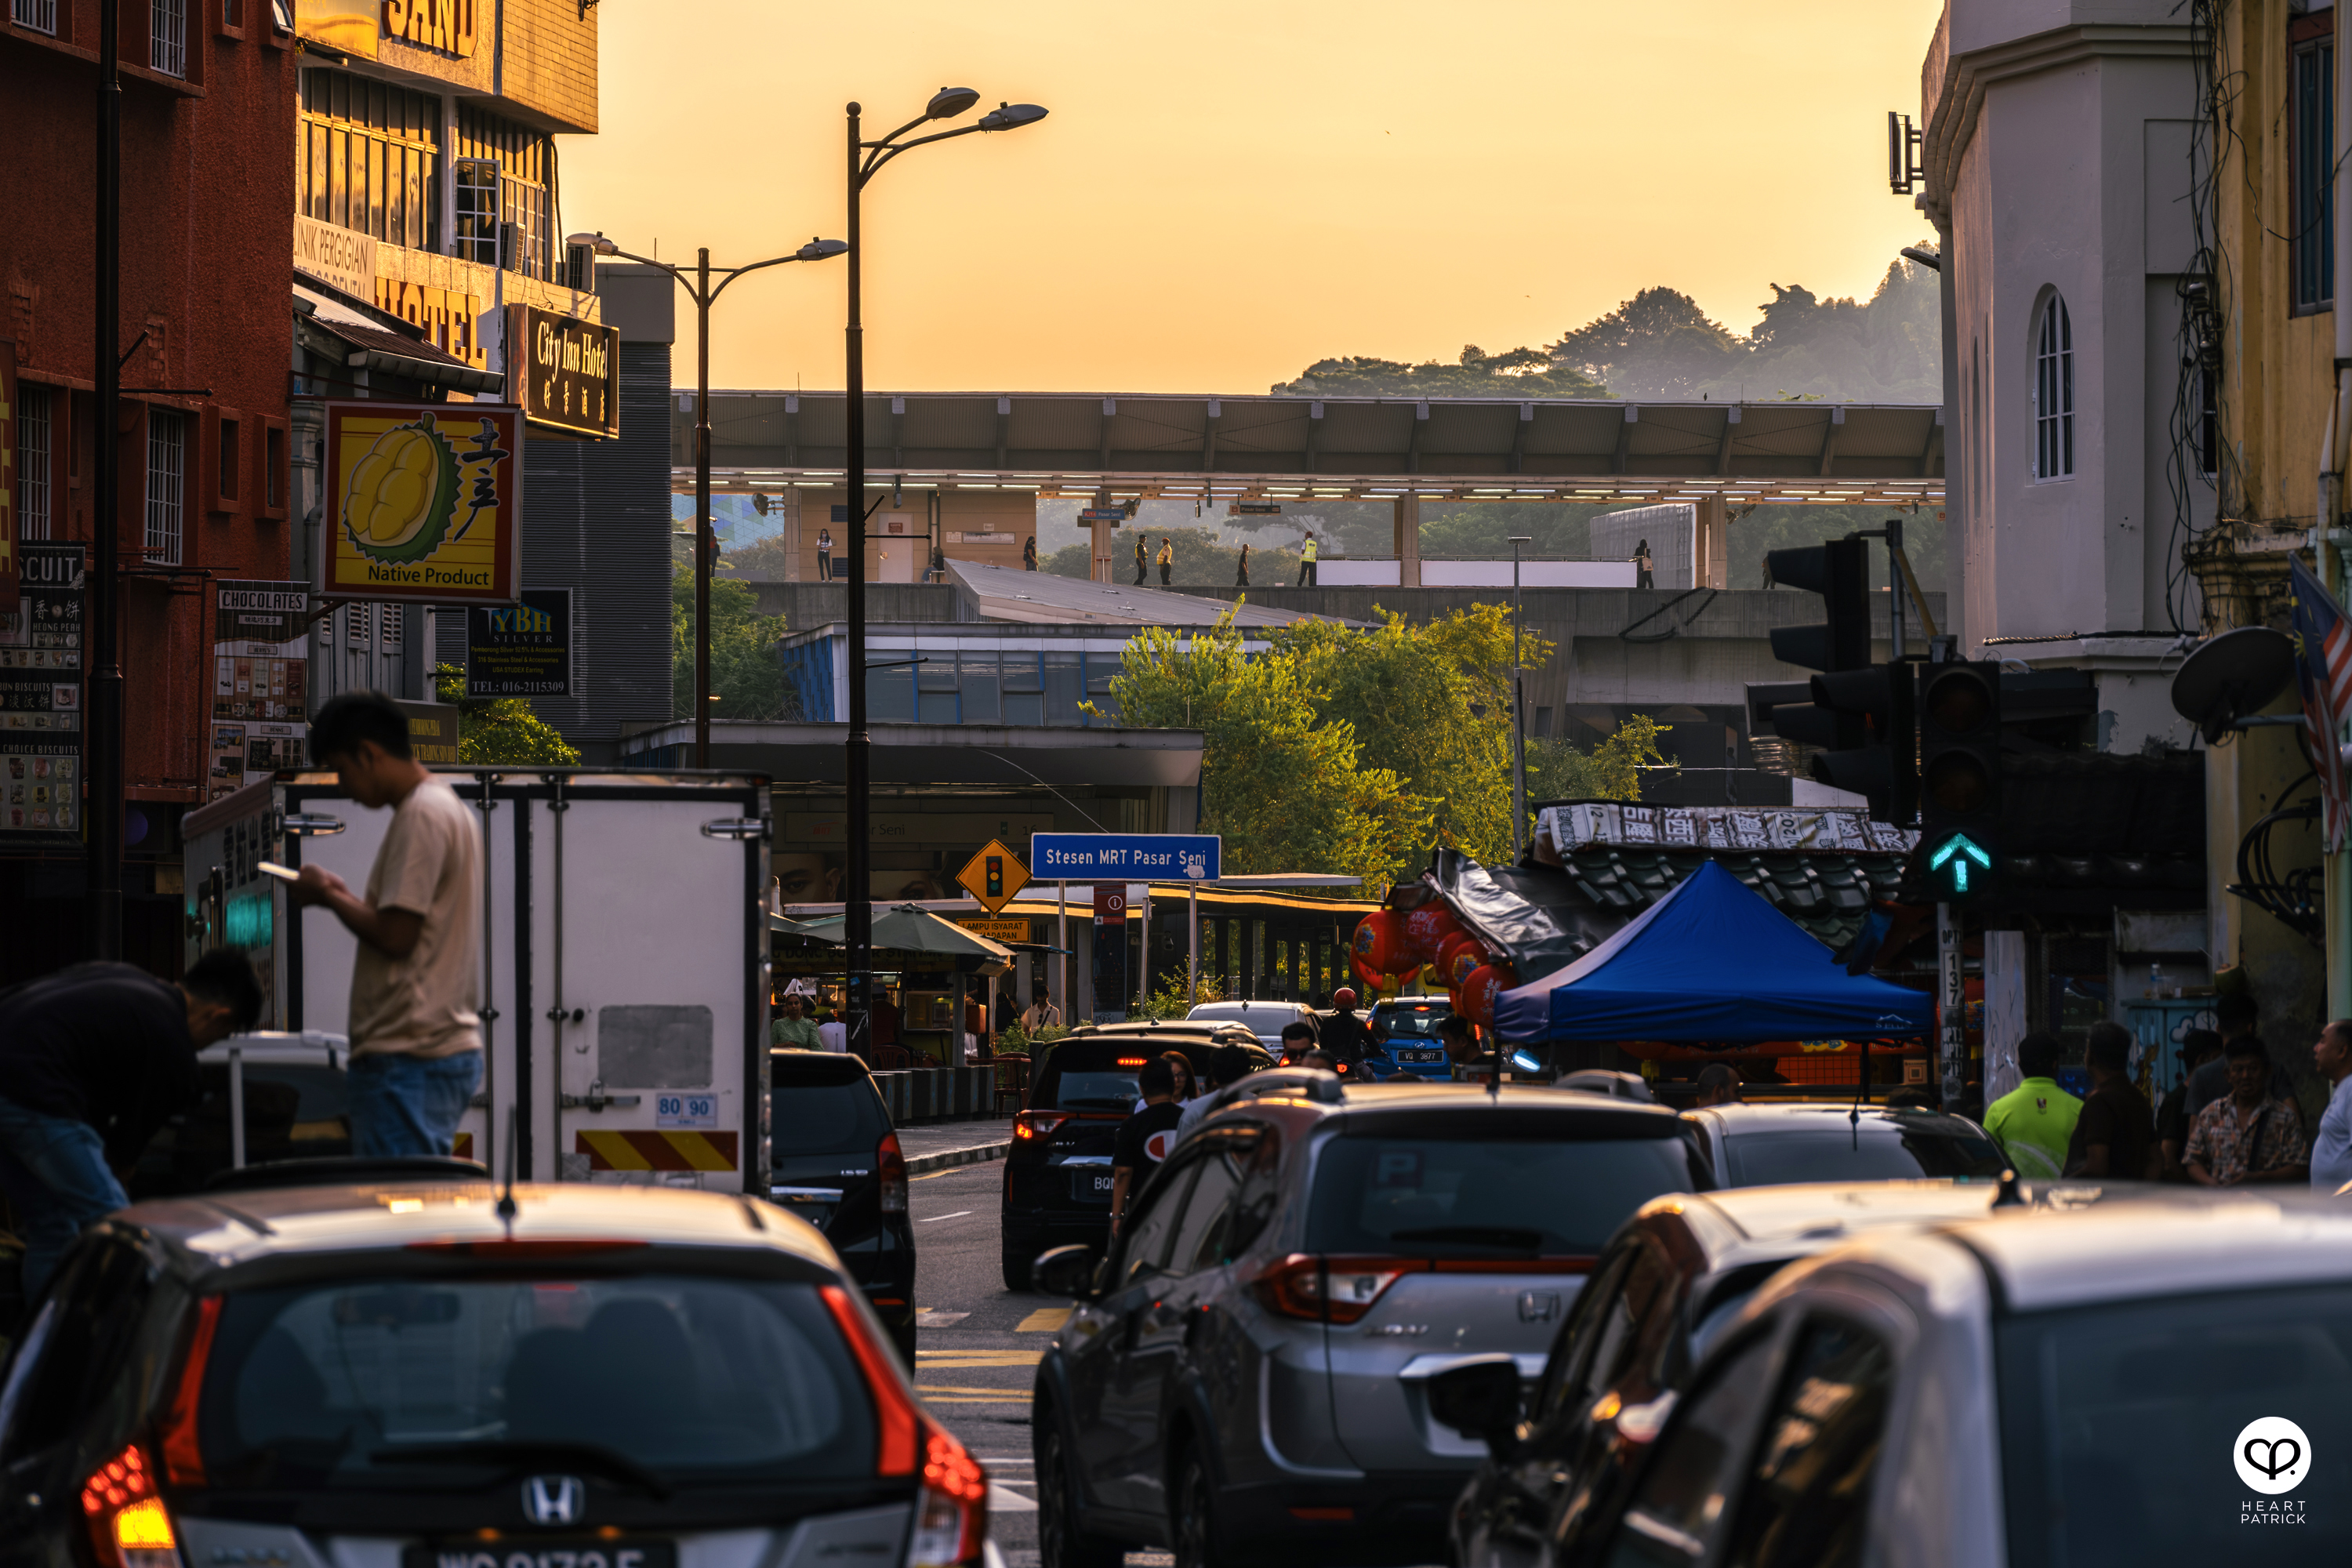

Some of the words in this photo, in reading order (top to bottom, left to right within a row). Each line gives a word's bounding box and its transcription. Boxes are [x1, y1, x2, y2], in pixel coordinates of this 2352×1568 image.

[319, 228, 368, 277] PERGIGIAN
[537, 320, 561, 383] City
[562, 327, 580, 373] Inn
[581, 332, 608, 380] Hotel
[368, 565, 421, 583] Native
[425, 567, 489, 586] Product
[223, 591, 303, 609] CHOCOLATES
[492, 602, 552, 633] YBH
[33, 622, 58, 631] HEONG
[60, 623, 80, 632] PEAH
[494, 634, 553, 643] SILVER
[15, 682, 50, 691] BISCUITS
[472, 681, 499, 692] TEL:
[502, 681, 564, 692] 016-2115309
[3, 744, 34, 753] CHOICE
[38, 745, 78, 754] BISCUITS
[879, 823, 905, 835] Seni
[1047, 848, 1093, 865] Stesen
[1099, 849, 1127, 865] MRT
[1134, 849, 1172, 866] Pasar
[1178, 849, 1206, 866] Seni
[991, 922, 1023, 931] ISYARAT
[659, 1098, 681, 1115] 80
[689, 1100, 709, 1116] 90
